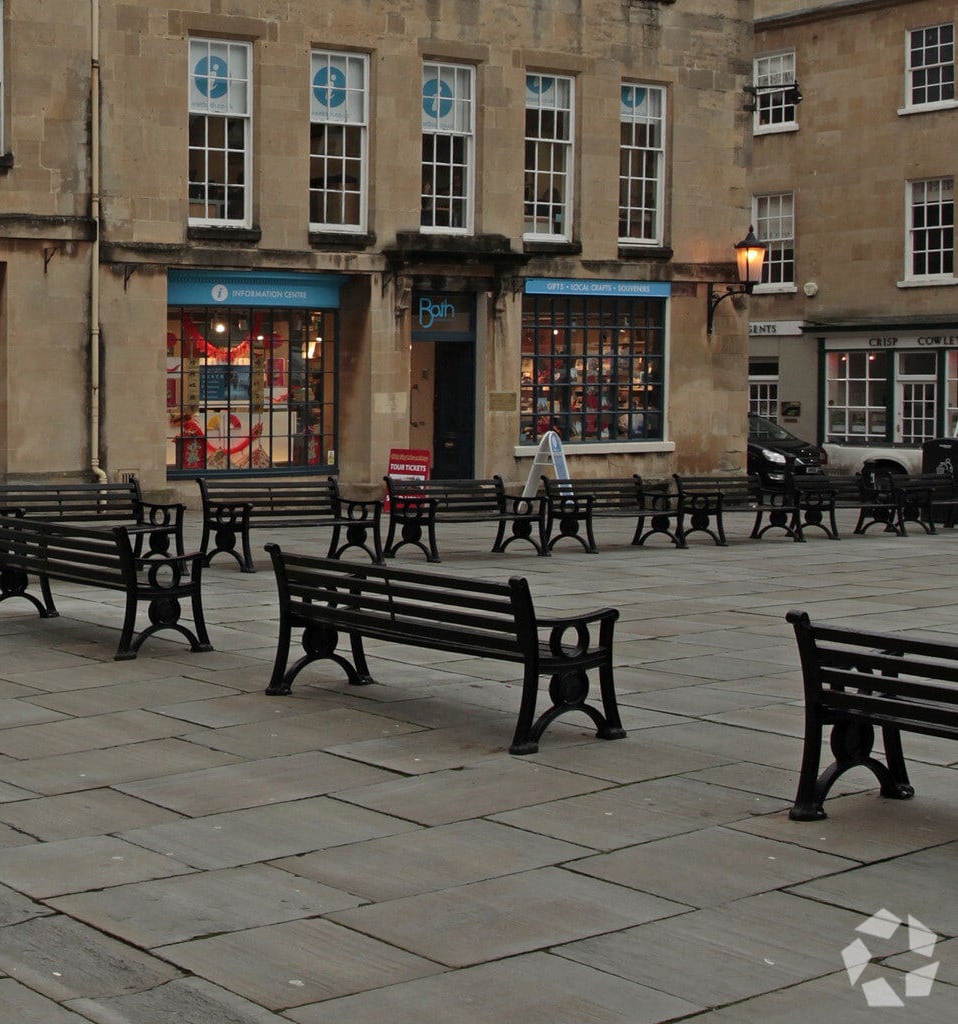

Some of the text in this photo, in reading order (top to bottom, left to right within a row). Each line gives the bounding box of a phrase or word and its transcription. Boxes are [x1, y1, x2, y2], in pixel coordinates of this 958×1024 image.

[546, 282, 651, 293] GIFTS LOCAL CRAFTS SOUVENIRS
[232, 289, 307, 299] INFORMATION CENTRE
[419, 296, 455, 329] Bath
[868, 337, 899, 347] CRISP
[390, 463, 427, 472] TOUR TICKETS
